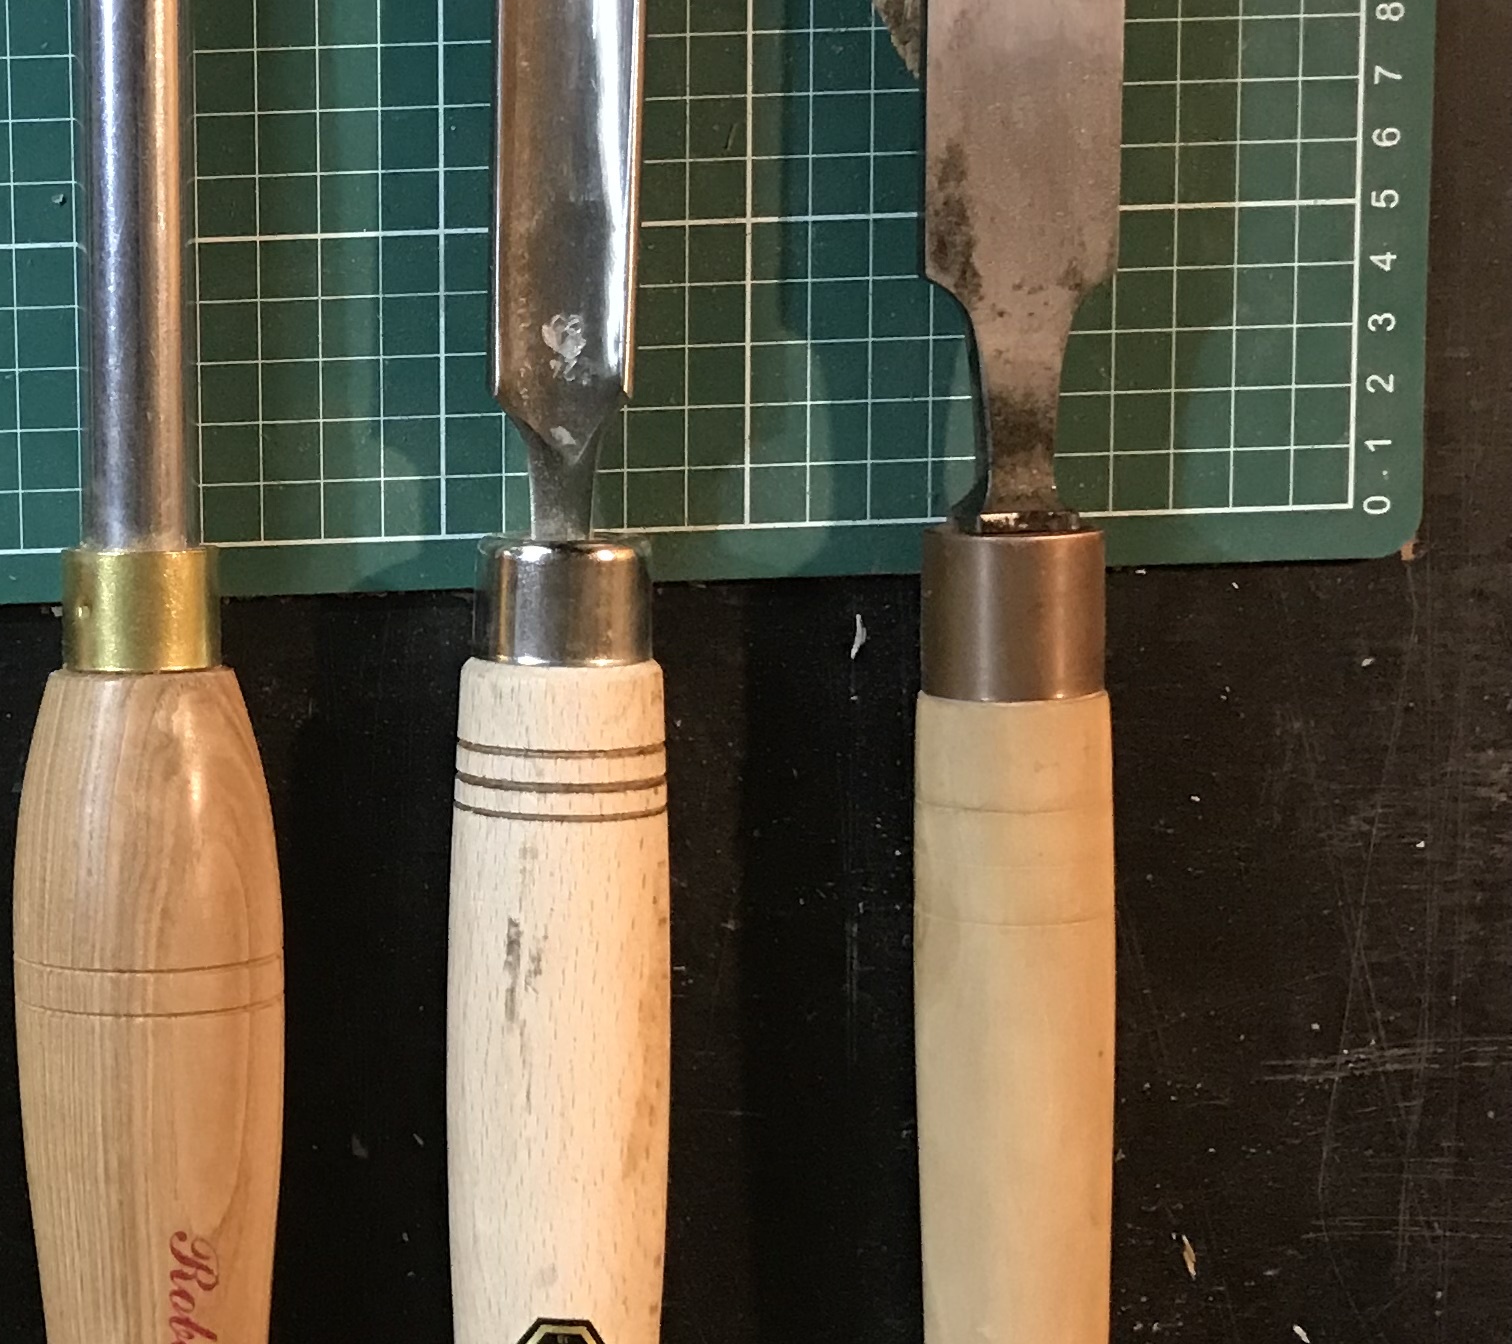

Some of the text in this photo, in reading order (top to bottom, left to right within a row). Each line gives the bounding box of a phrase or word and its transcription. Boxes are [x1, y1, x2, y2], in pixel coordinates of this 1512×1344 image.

[1375, 1, 1405, 22] 8
[1373, 65, 1403, 85] 7
[1371, 127, 1401, 147] 6
[1370, 189, 1399, 209] 5
[1369, 251, 1397, 272] 4
[1367, 312, 1396, 332] 3
[1365, 373, 1395, 393] 2
[1363, 439, 1392, 452] 1
[1362, 495, 1391, 515] 0
